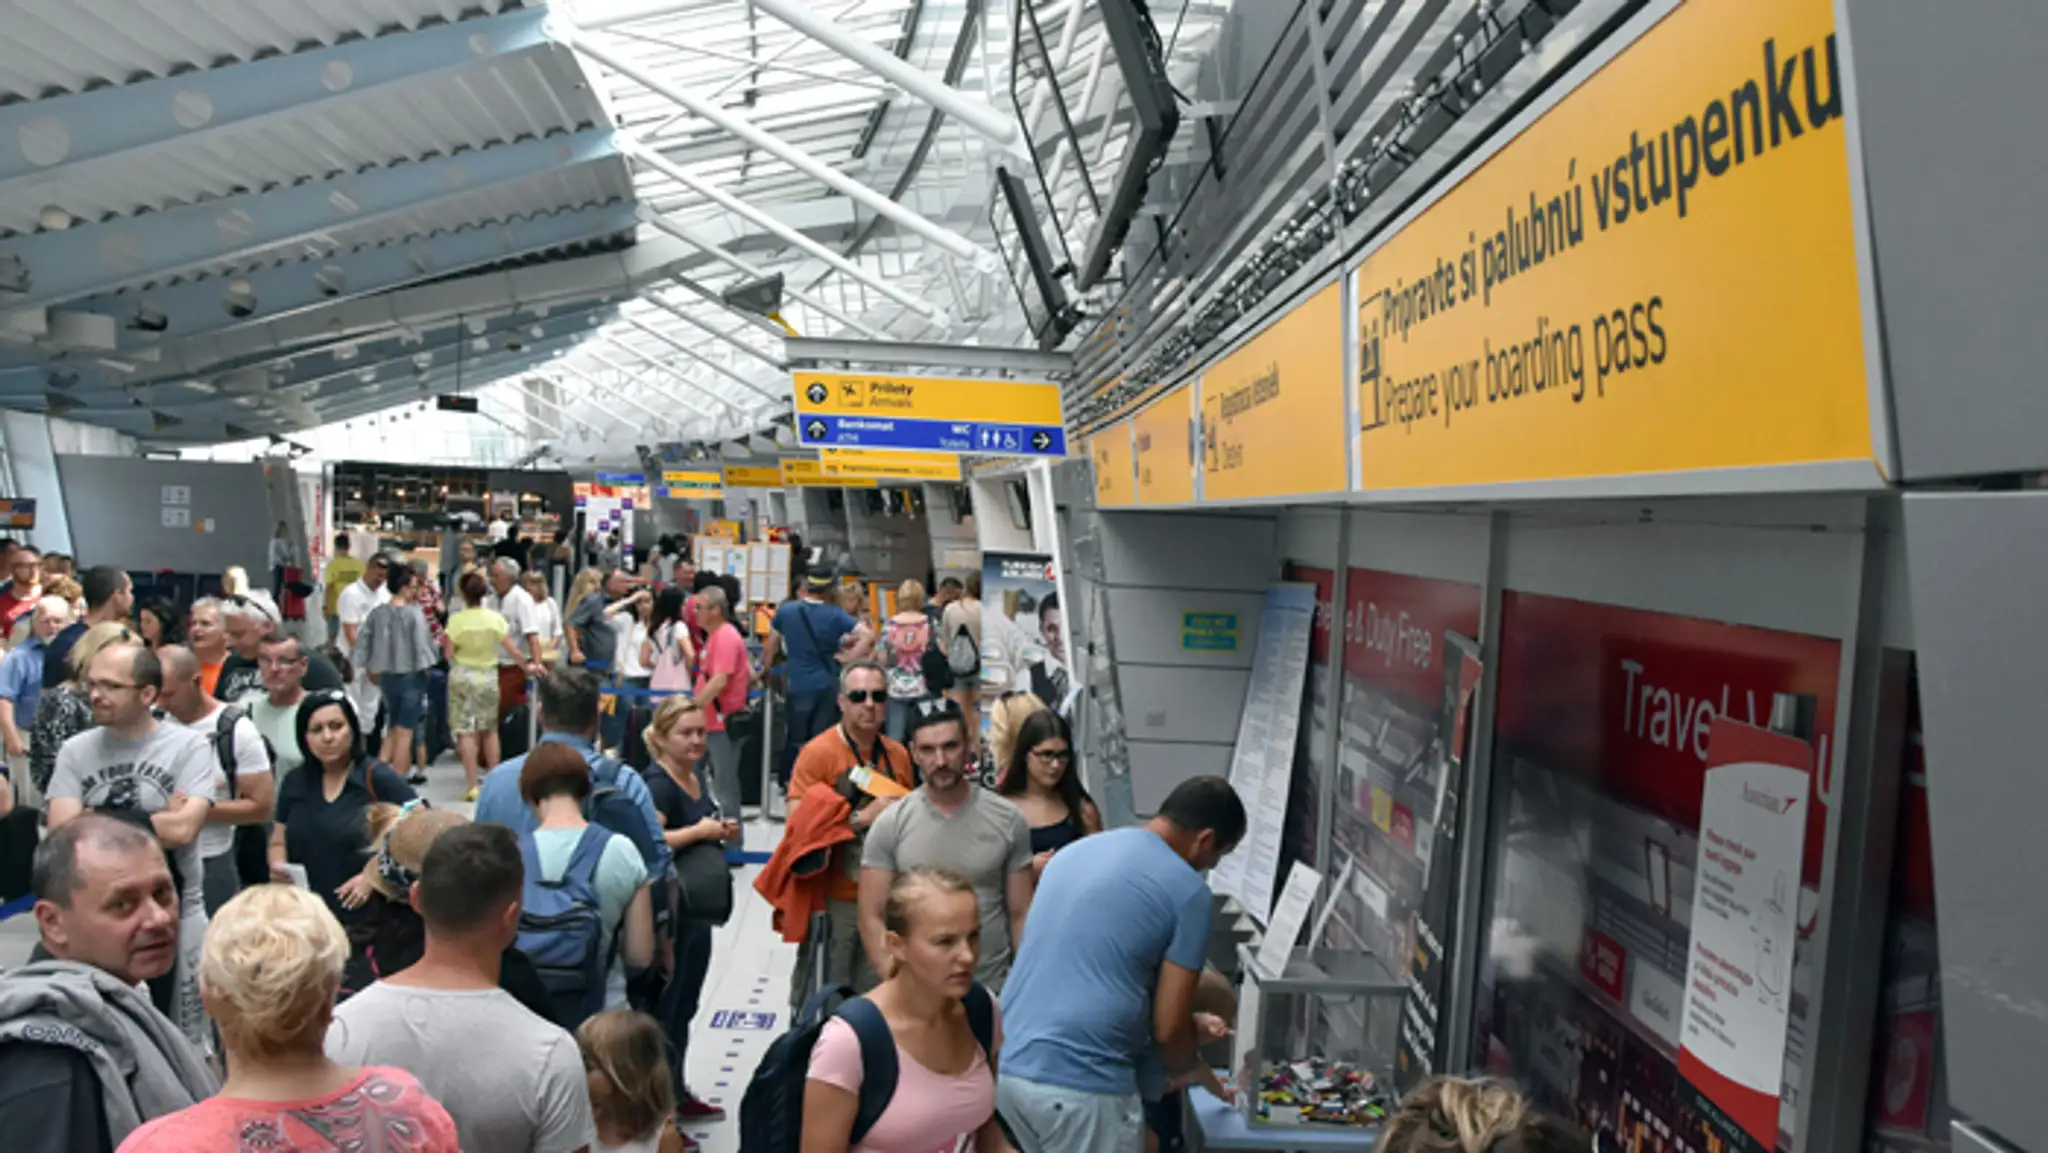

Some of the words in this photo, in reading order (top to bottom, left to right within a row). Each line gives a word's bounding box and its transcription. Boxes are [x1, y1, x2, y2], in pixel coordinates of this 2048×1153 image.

[1382, 256, 1456, 343] Pripravte
[1459, 231, 1477, 304] si
[1482, 157, 1583, 307] palubnú
[1591, 31, 1843, 231] vstupenku
[1384, 368, 1438, 435] Prepare
[1441, 359, 1480, 428] your
[1484, 316, 1585, 403] boarding
[1593, 295, 1668, 399] pass
[951, 423, 971, 435] WC
[1366, 602, 1398, 668] Duty
[1400, 610, 1431, 669] Free
